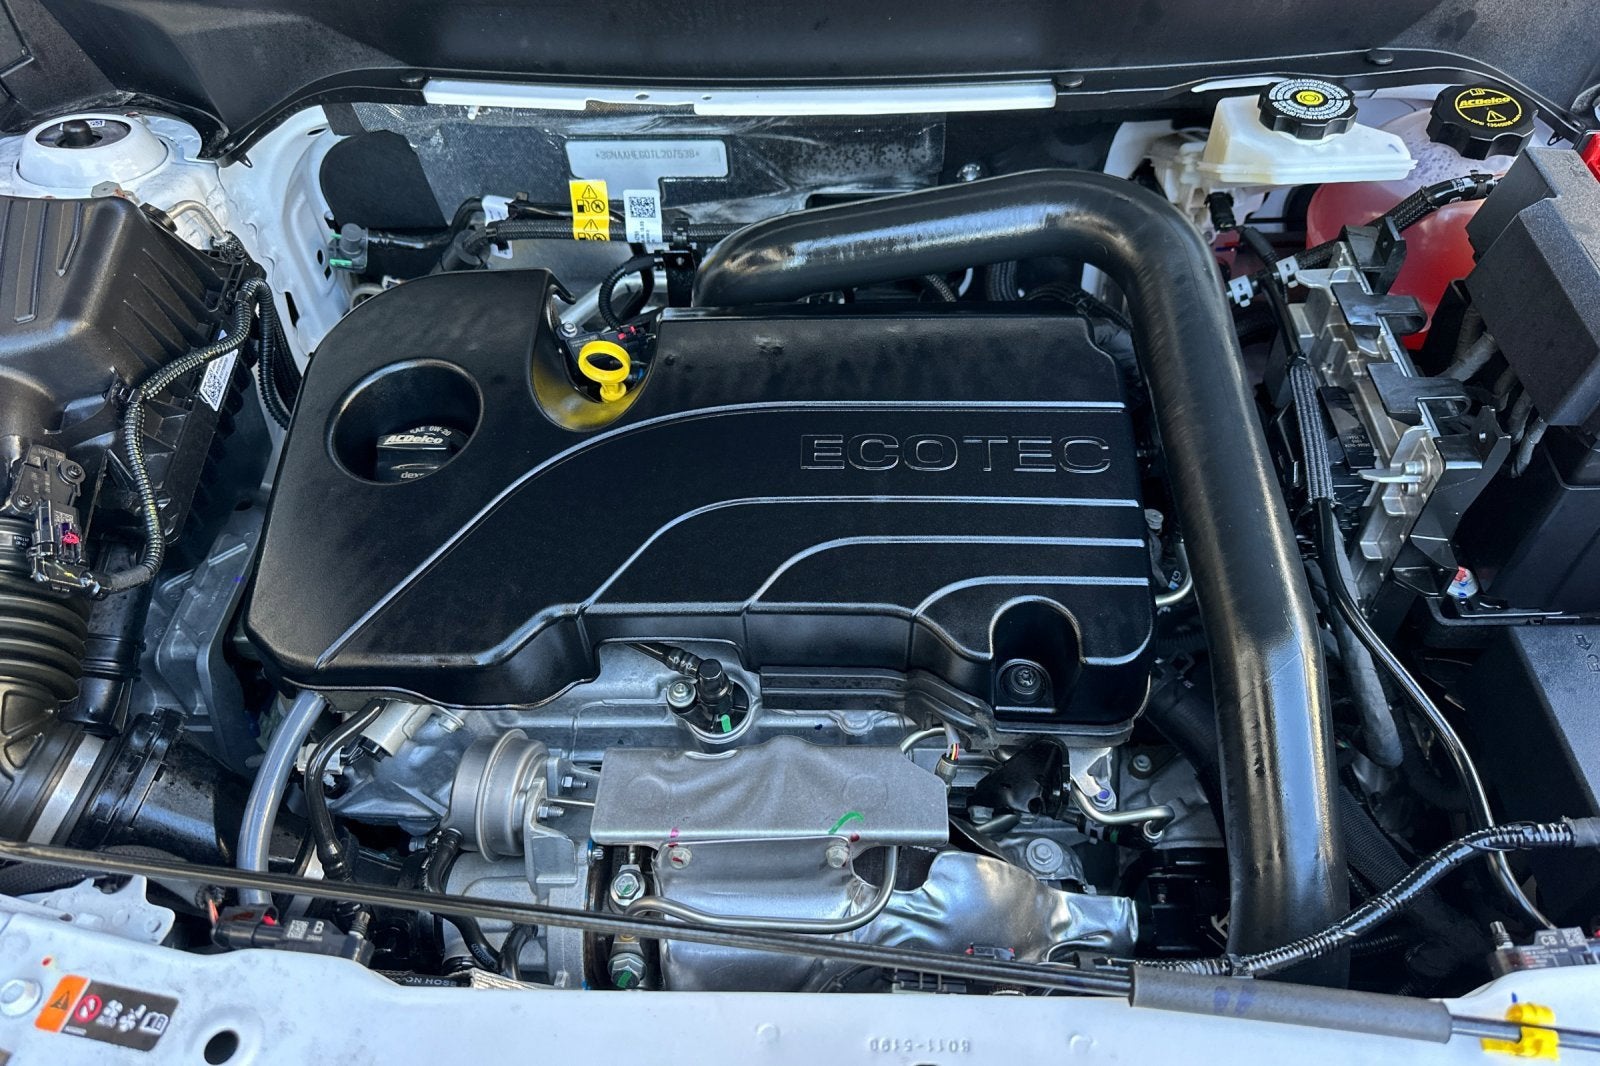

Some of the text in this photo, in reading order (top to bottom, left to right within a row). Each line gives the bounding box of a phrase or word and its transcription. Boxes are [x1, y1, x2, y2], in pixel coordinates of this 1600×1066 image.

[1459, 96, 1511, 108] ACDelco
[409, 426, 426, 434] SAE
[383, 434, 444, 445] ACDelco
[800, 433, 1111, 474] ECOTEC
[313, 920, 325, 934] B
[1540, 935, 1558, 946] CB
